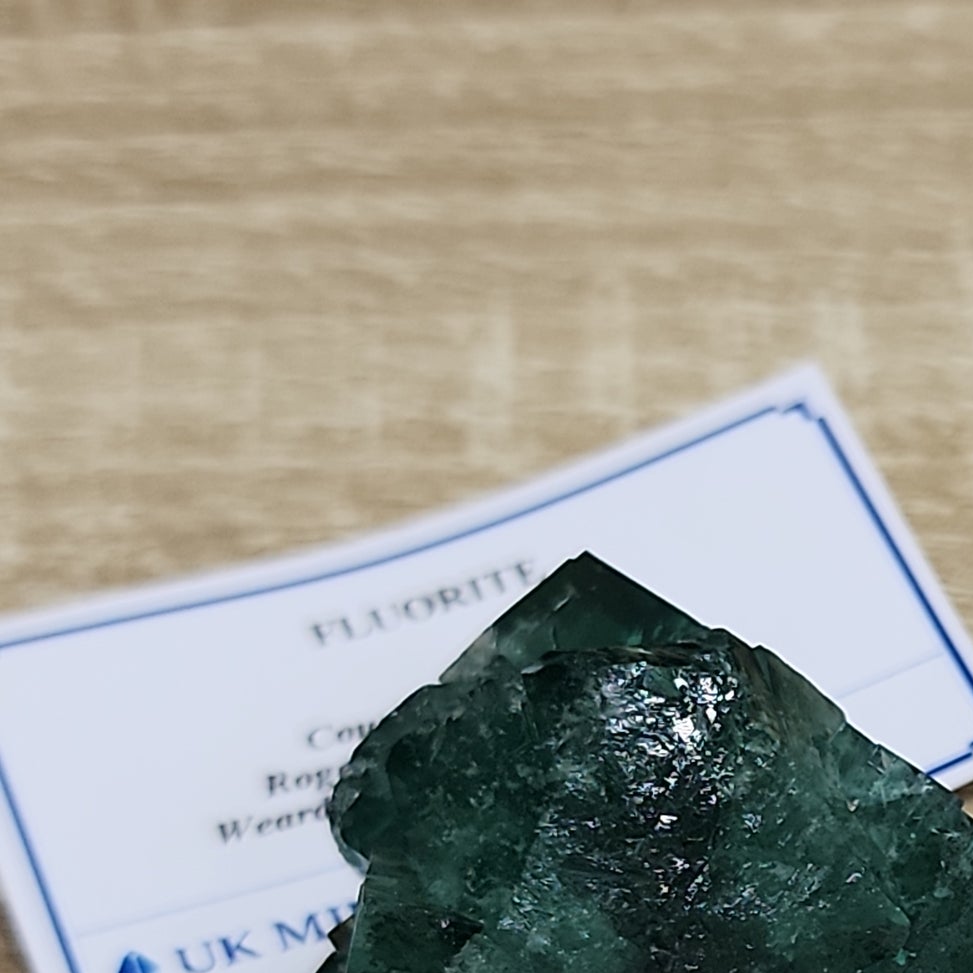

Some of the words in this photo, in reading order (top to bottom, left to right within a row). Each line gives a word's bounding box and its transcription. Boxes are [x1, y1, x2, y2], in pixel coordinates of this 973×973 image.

[310, 557, 536, 645] FLUORITE
[176, 931, 260, 973] UK
[274, 901, 357, 949] MI
